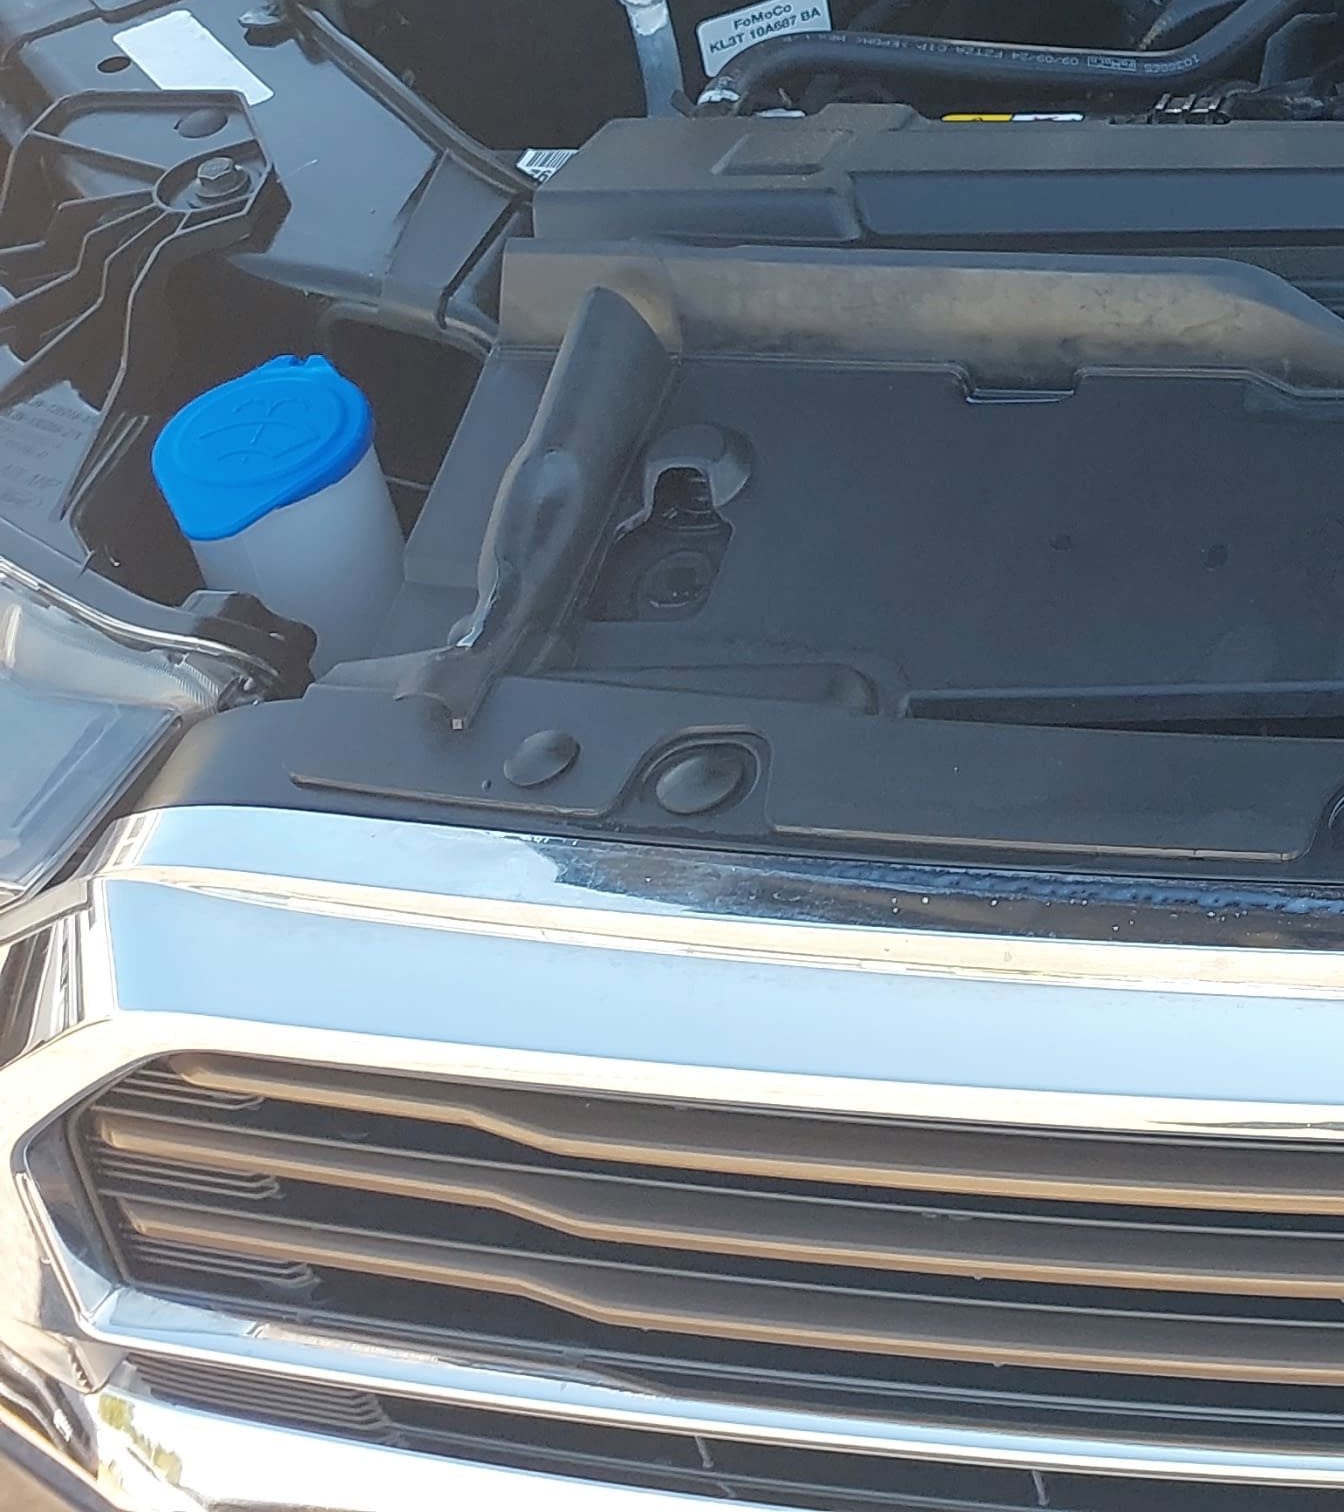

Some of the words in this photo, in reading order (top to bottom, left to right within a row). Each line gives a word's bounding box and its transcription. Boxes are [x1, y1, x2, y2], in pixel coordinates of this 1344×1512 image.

[709, 33, 746, 54] KL3T
[800, 6, 821, 22] BA
[732, 3, 793, 31] FoMoCo
